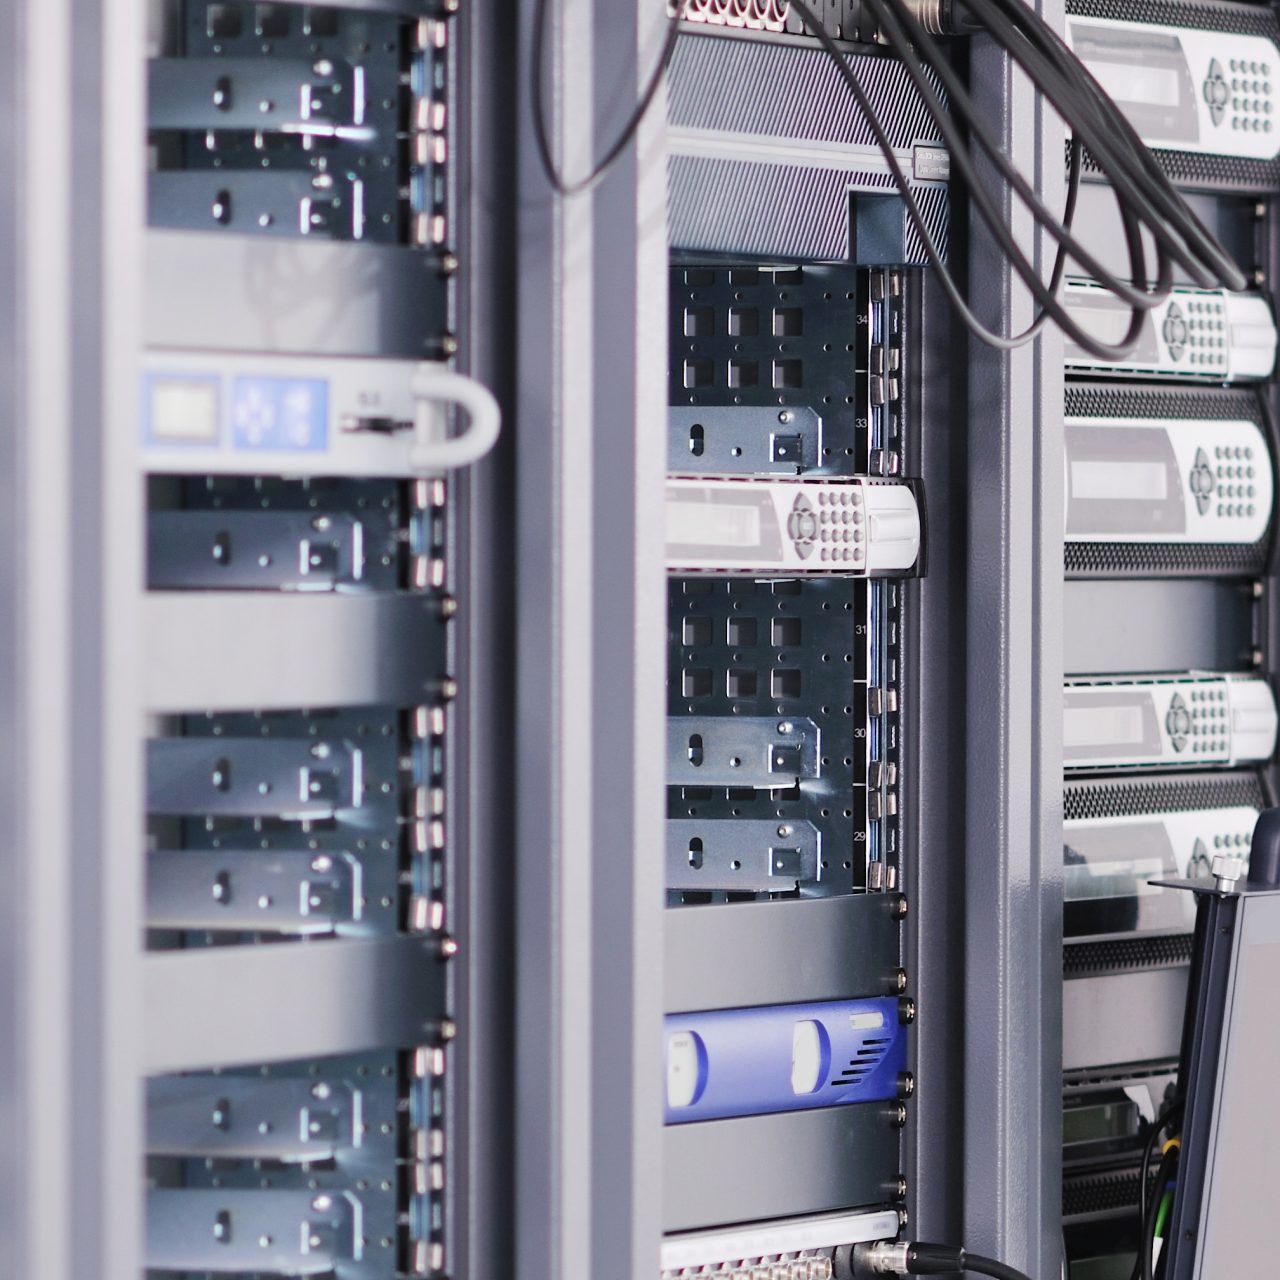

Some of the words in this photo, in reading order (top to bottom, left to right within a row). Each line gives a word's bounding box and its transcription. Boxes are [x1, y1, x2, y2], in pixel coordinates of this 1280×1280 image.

[856, 315, 868, 325] 34
[855, 418, 867, 428] 33
[855, 625, 866, 635] 31
[854, 728, 867, 738] 30
[853, 831, 866, 842] 29
